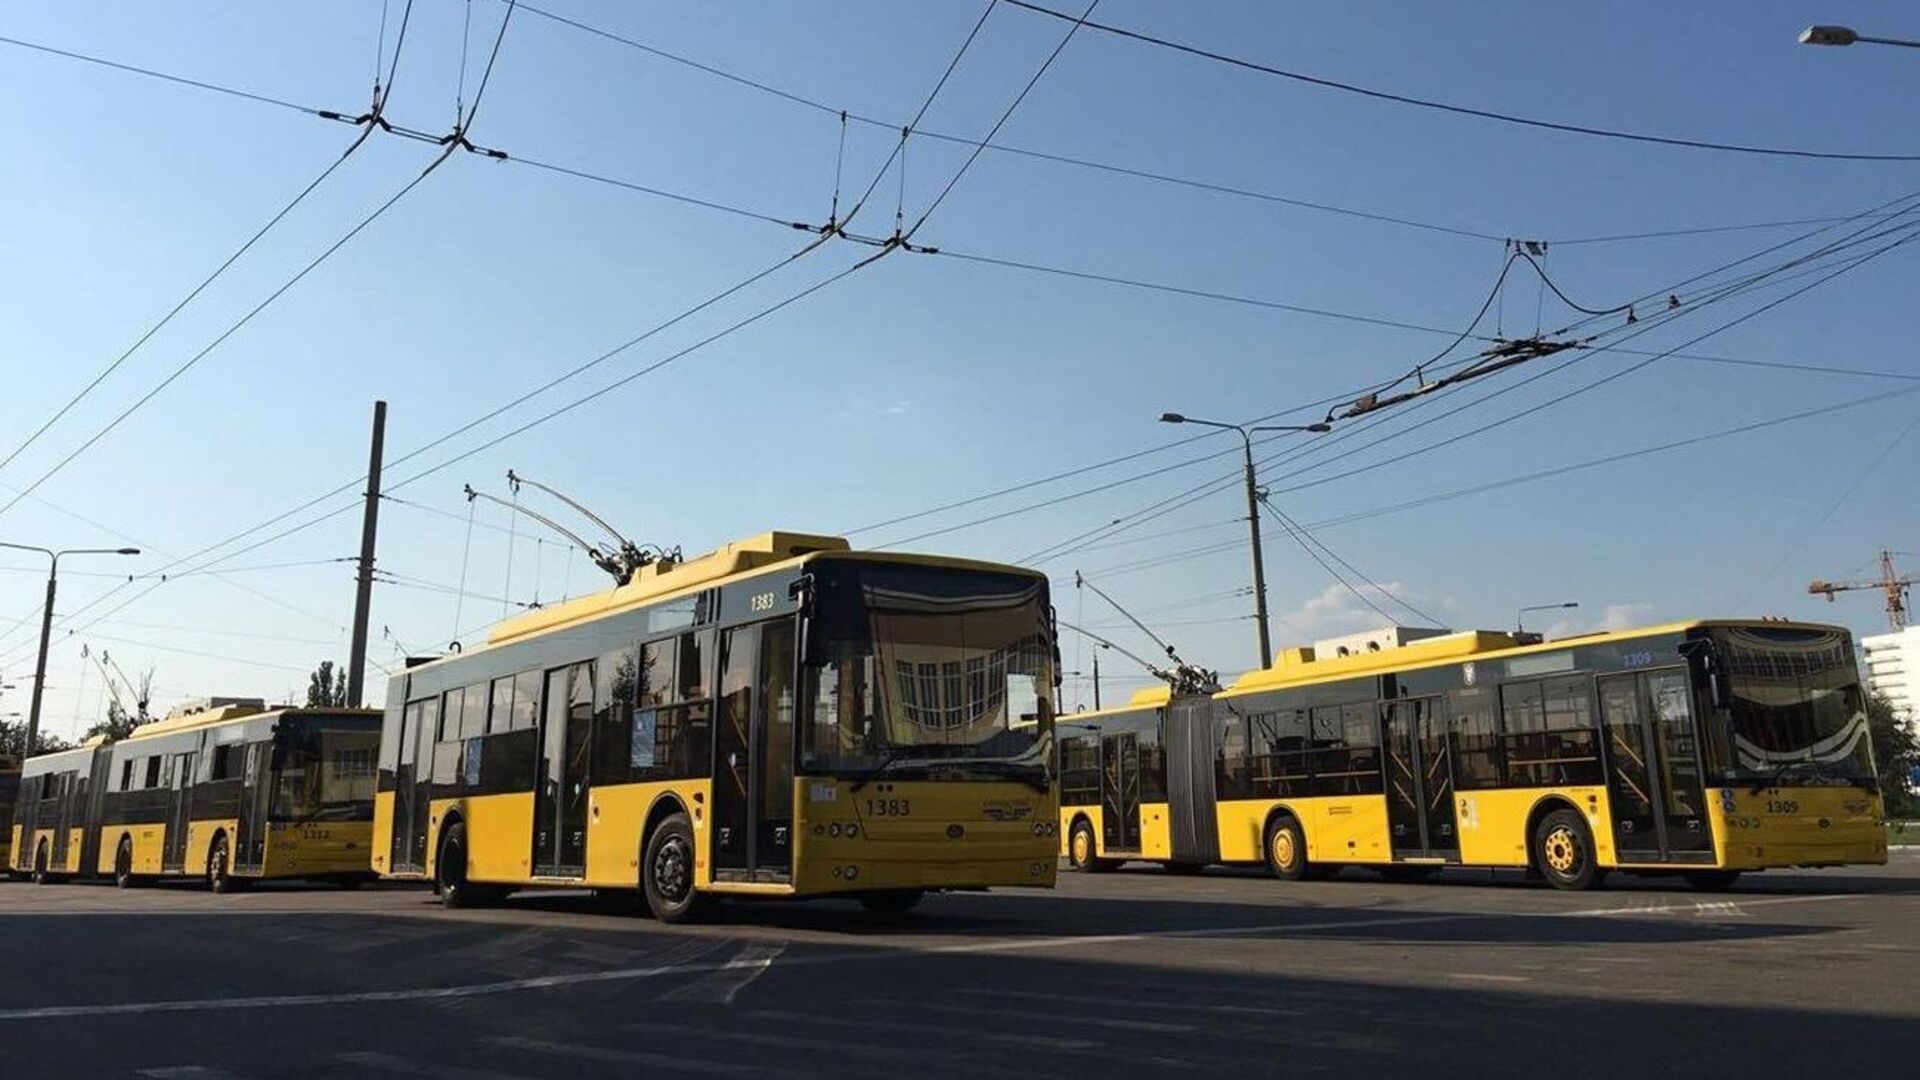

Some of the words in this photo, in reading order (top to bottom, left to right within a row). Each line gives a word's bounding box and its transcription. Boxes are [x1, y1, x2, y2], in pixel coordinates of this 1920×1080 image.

[751, 592, 775, 612] 1383
[866, 800, 910, 816] 1383
[1766, 801, 1799, 814] 1309
